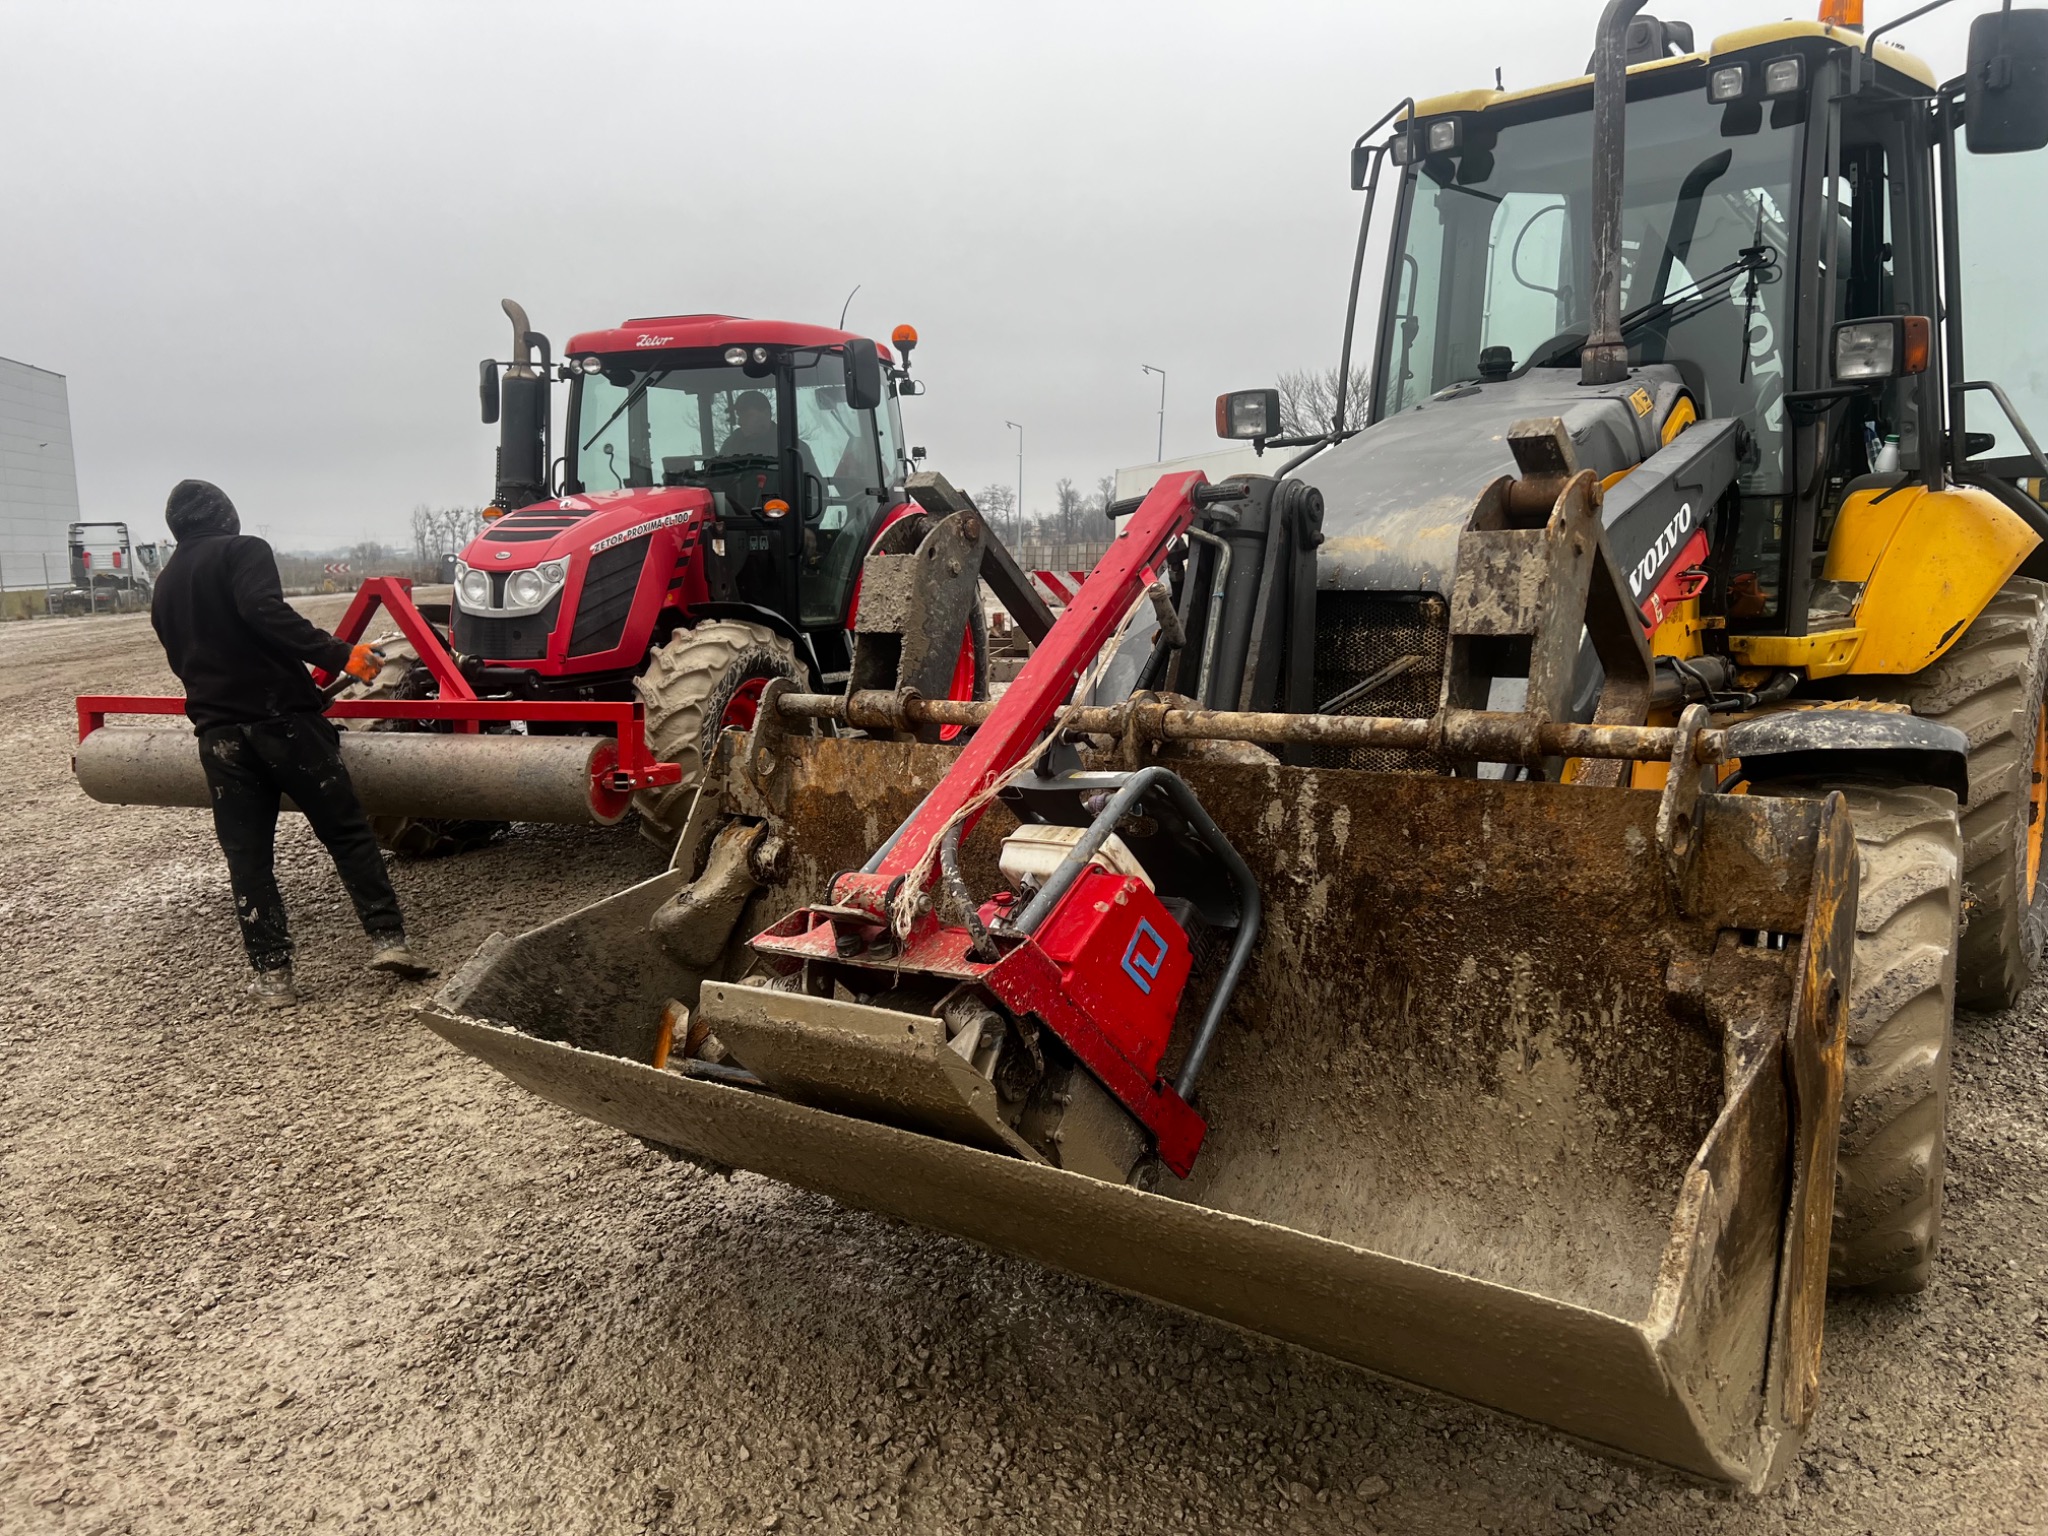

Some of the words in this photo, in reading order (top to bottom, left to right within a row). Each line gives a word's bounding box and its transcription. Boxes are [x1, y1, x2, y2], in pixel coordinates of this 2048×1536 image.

[636, 334, 674, 347] Zetor
[594, 533, 624, 553] ZETOR
[626, 518, 663, 539] PROXIMA
[674, 511, 690, 524] 100
[1629, 502, 1691, 597] VOLVO
